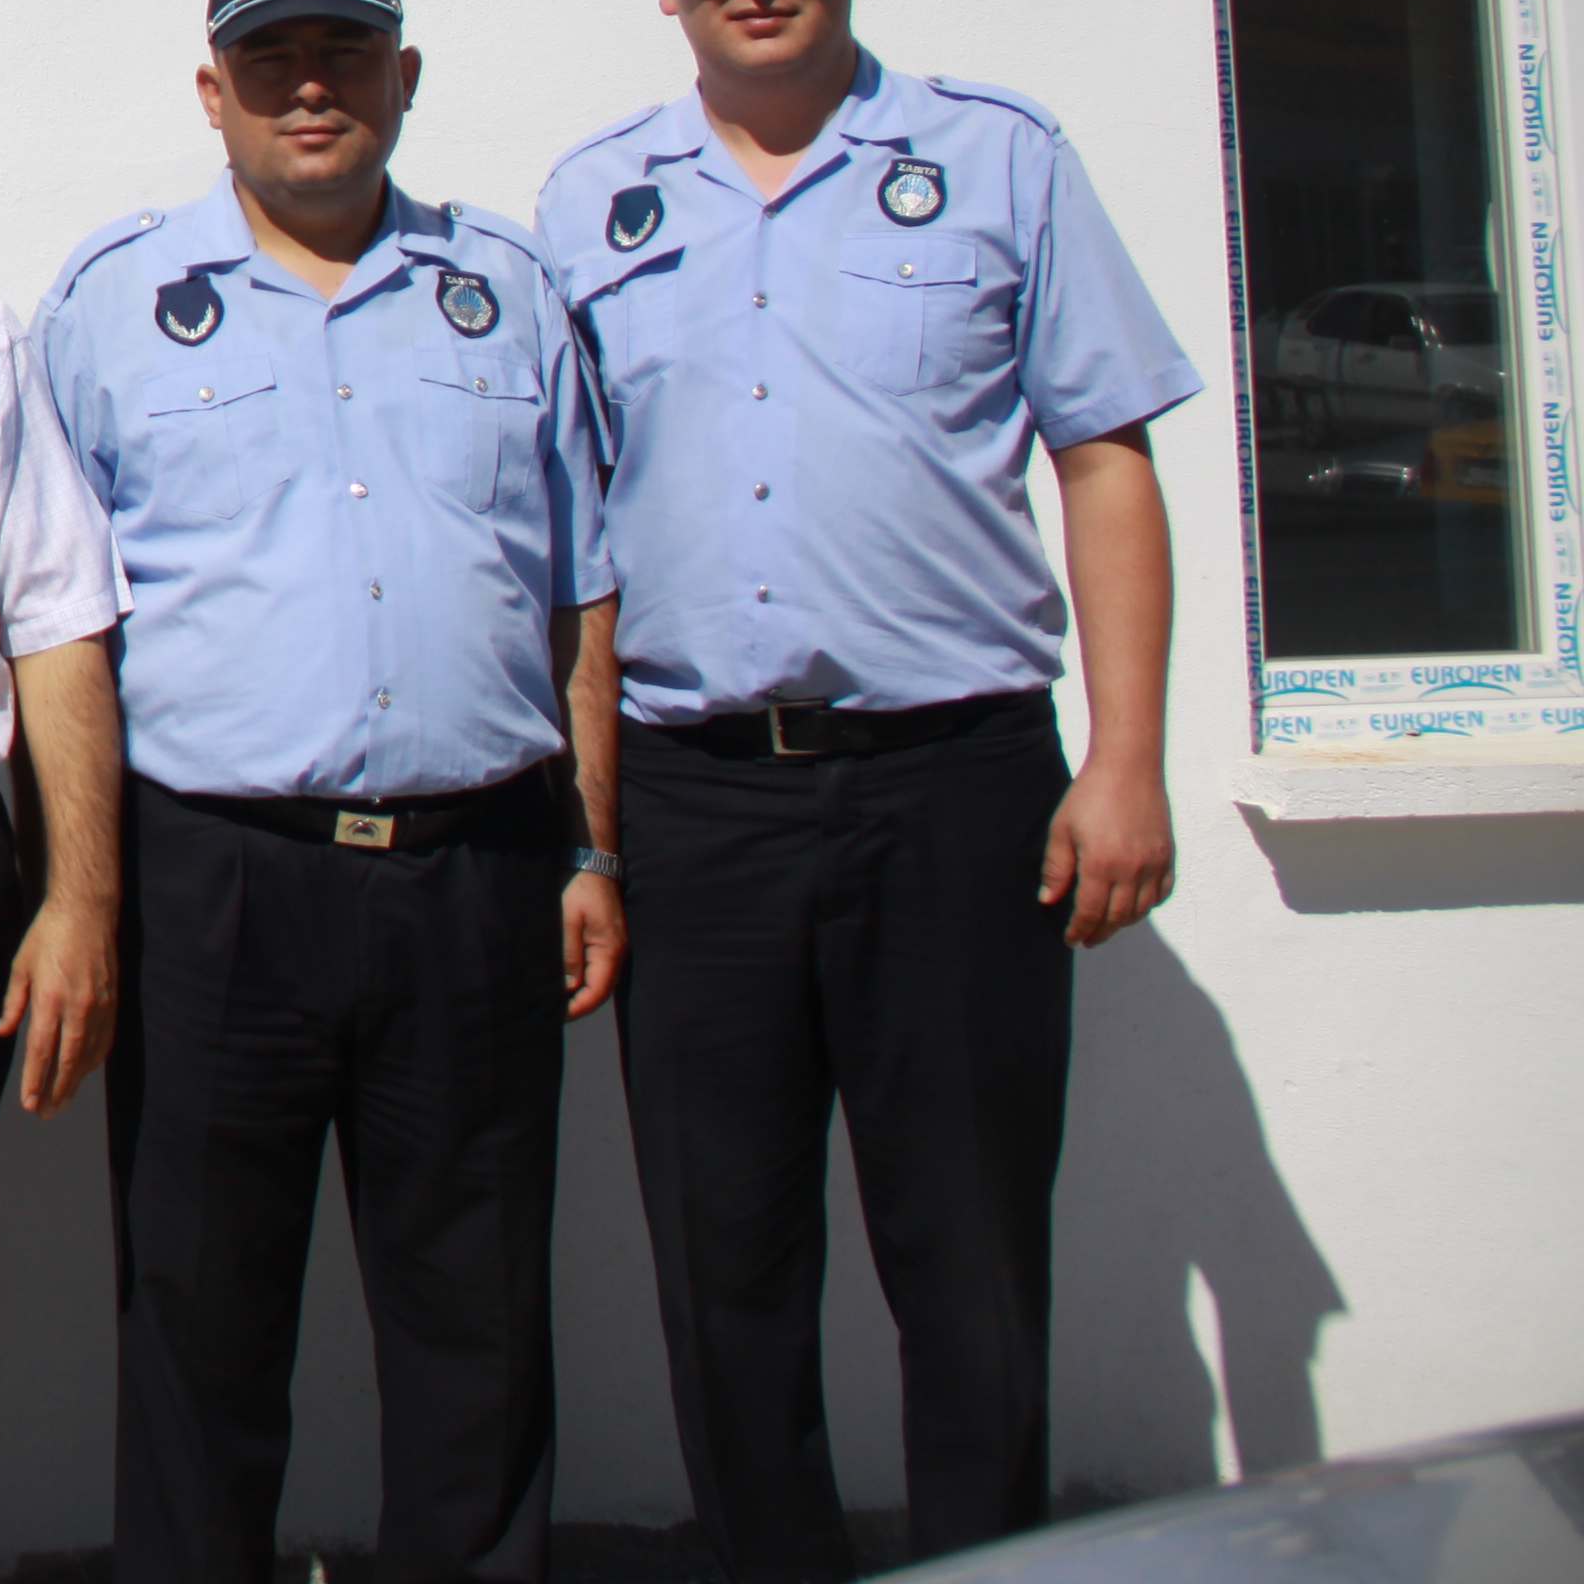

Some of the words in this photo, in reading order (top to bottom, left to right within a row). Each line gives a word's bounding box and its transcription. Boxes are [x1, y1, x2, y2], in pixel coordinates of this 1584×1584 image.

[1518, 43, 1541, 162] EUROPEN
[1531, 222, 1554, 341] EUROPEN
[1543, 401, 1566, 522] EUROPEN
[1369, 710, 1484, 733] EUROPEN
[1410, 664, 1522, 686] EUROPEN
